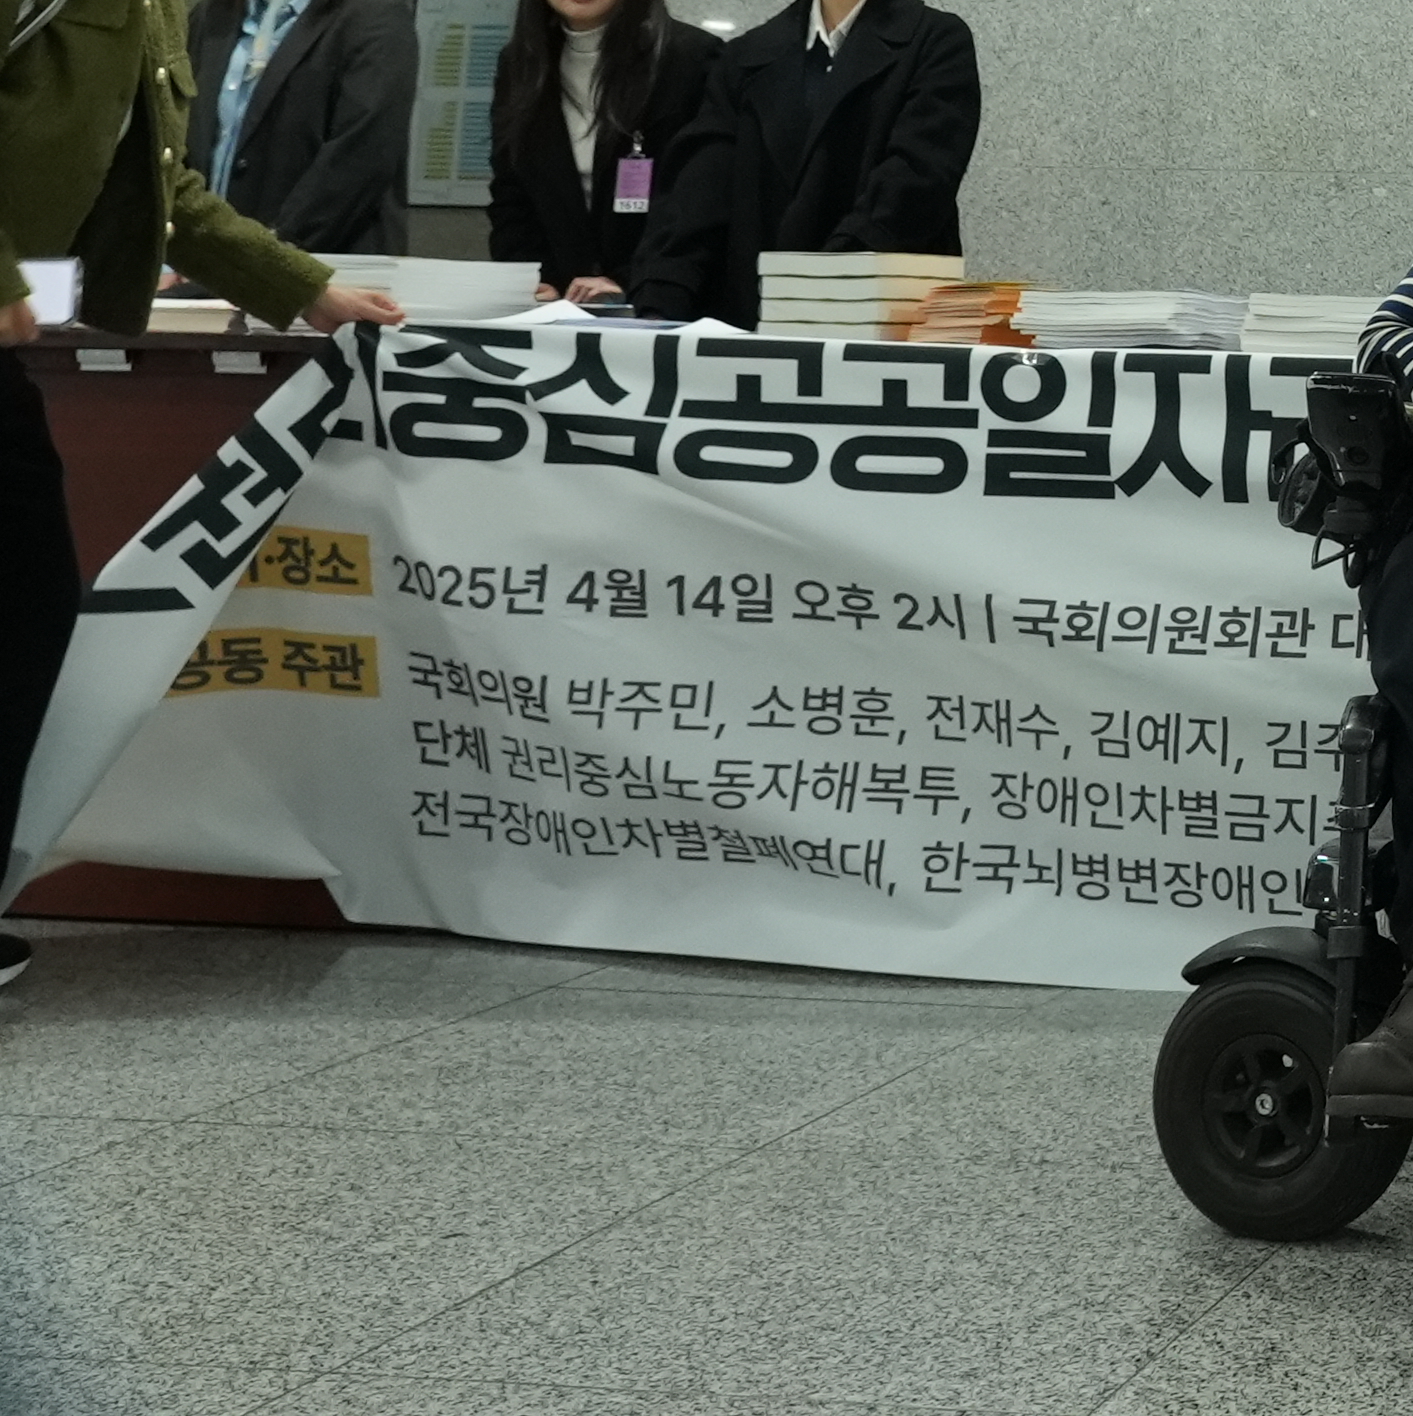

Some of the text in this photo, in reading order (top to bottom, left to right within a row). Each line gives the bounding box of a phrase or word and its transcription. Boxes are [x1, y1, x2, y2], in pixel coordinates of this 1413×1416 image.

[392, 554, 551, 618] 2025년
[566, 568, 651, 620] 4월
[665, 573, 776, 624] 14일
[792, 581, 881, 632] 오후
[892, 591, 968, 642] 2시
[1012, 597, 1316, 661] 국회의원회관
[280, 639, 365, 692] 주관
[406, 649, 550, 724] 국회의원
[567, 675, 727, 742] 박주민,
[748, 684, 907, 746] 소병훈,
[925, 693, 1073, 760] 전재수,
[1089, 710, 1245, 776] 김예지,
[412, 719, 492, 775] 단체
[501, 735, 973, 825] 권리중심노동자해복투,
[989, 770, 1338, 847] 장애인차별금지
[409, 789, 898, 897] 전국장애인차별철폐연대,
[922, 841, 1304, 917] 한국뇌병변장애인
